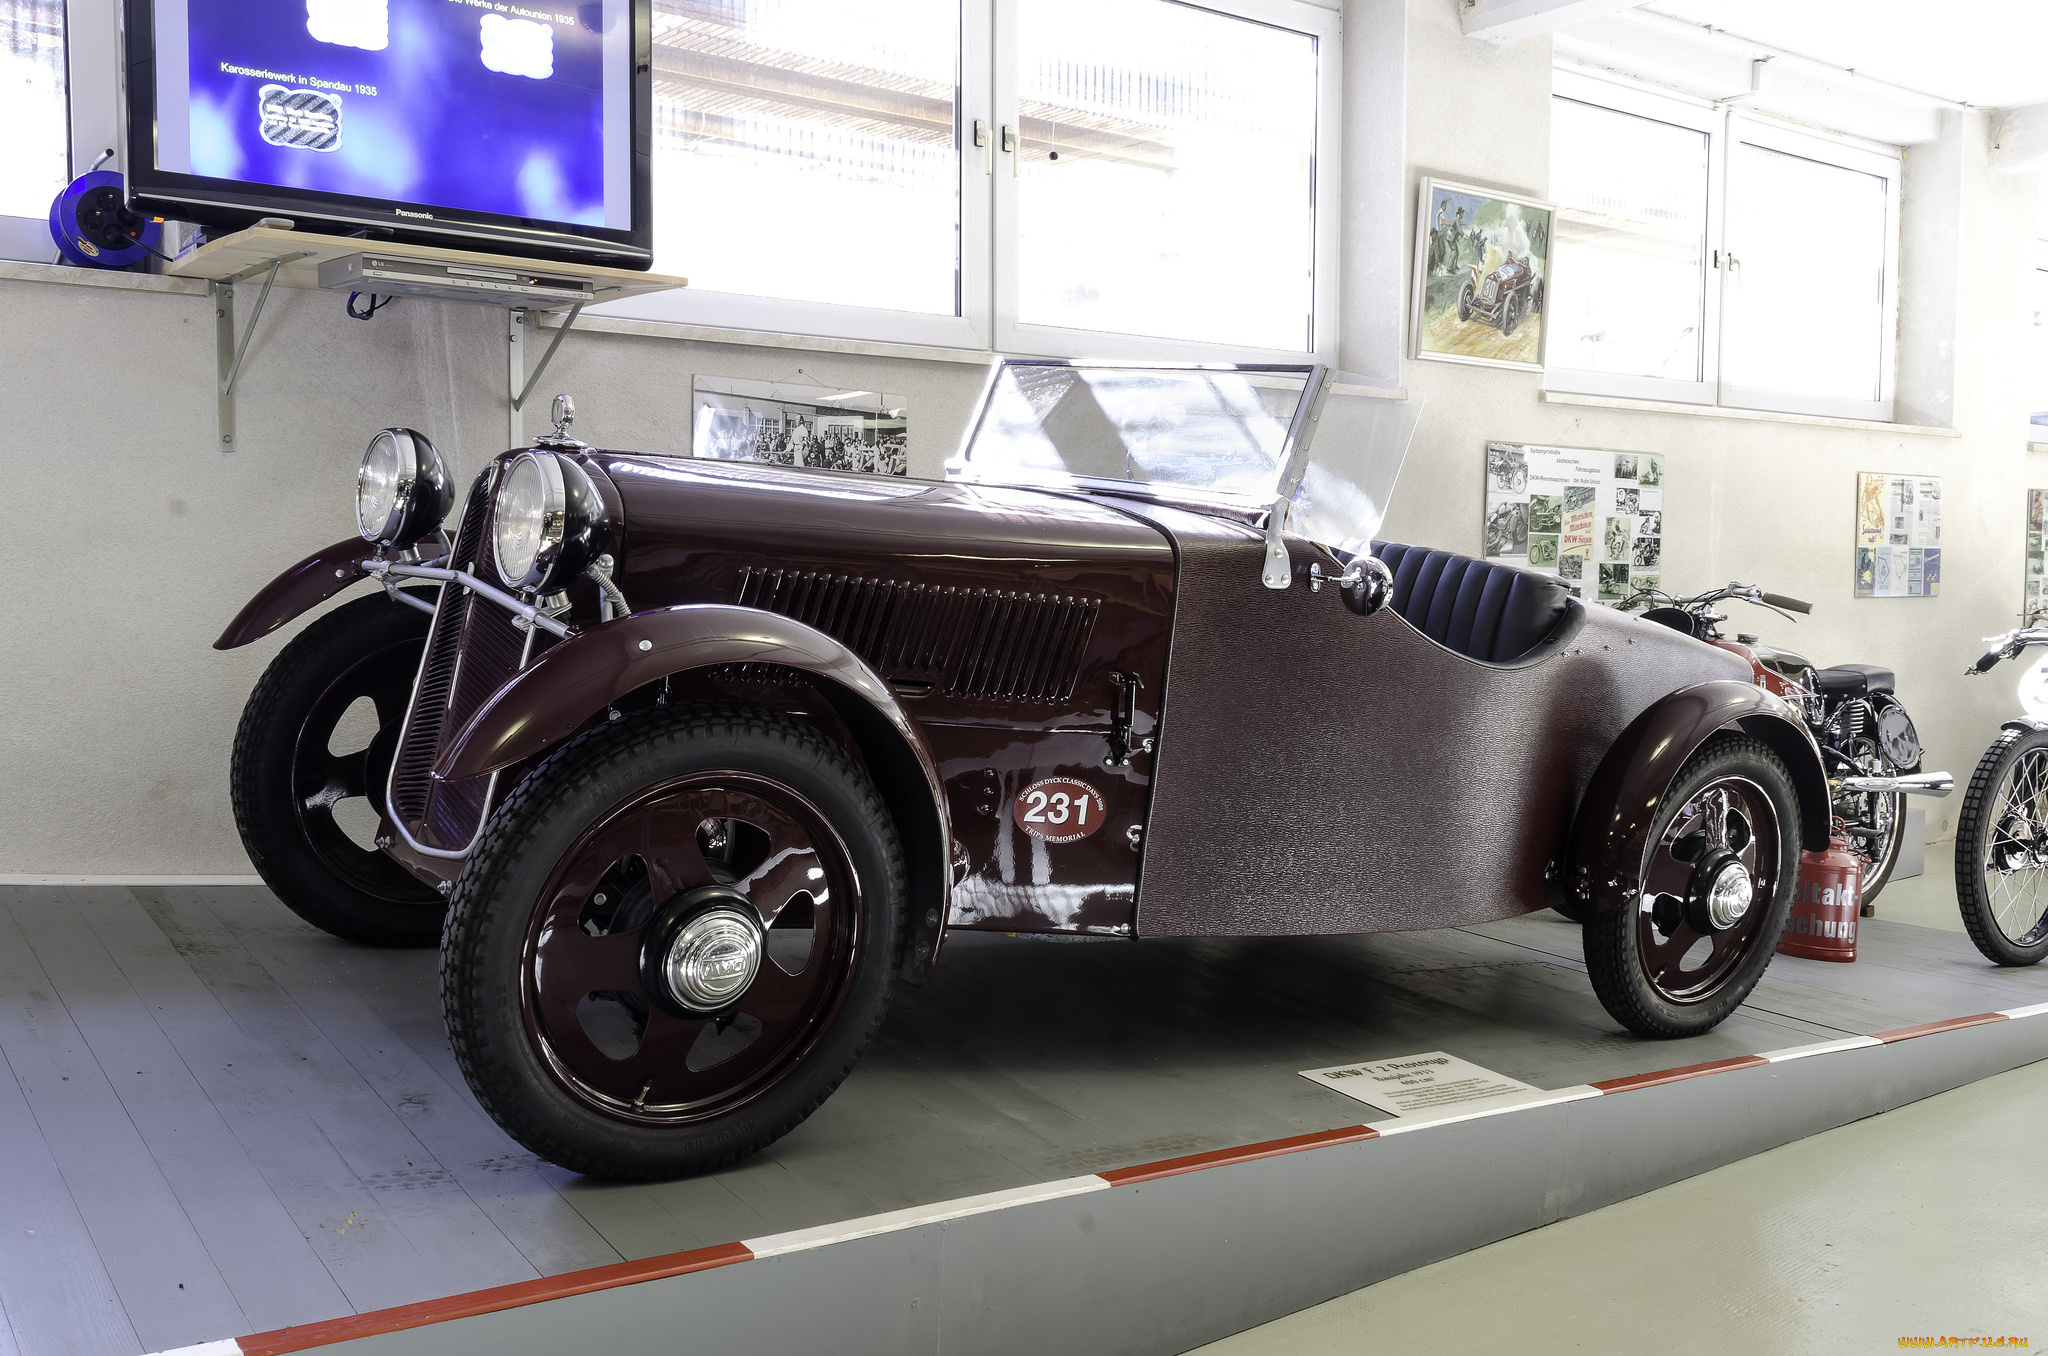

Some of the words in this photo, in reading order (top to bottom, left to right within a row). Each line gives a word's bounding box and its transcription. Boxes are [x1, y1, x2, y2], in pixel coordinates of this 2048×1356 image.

[494, 2, 509, 13] der
[510, 5, 553, 21] Autounion
[554, 14, 575, 26] 1935
[220, 62, 297, 84] Karosseriewerk
[298, 75, 308, 86] in
[309, 76, 352, 92] Spandau
[354, 84, 378, 97] 1935
[395, 208, 434, 220] Panasonic
[1530, 447, 1561, 455] Spitzenprodukte
[1019, 780, 1044, 802] SCHLOSS
[1044, 777, 1062, 786] DYCK
[1062, 777, 1087, 789] CLASSIC
[1085, 785, 1100, 799] DAYS
[1023, 790, 1090, 826] 231
[1024, 824, 1044, 840] TRIPS
[1045, 831, 1086, 843] MEMORIAL
[1793, 879, 1859, 906] eitakt-
[1786, 912, 1857, 944] schung
[1322, 1068, 1364, 1079] DKW
[1362, 1066, 1375, 1074] F
[1386, 1057, 1450, 1070] Prototyp
